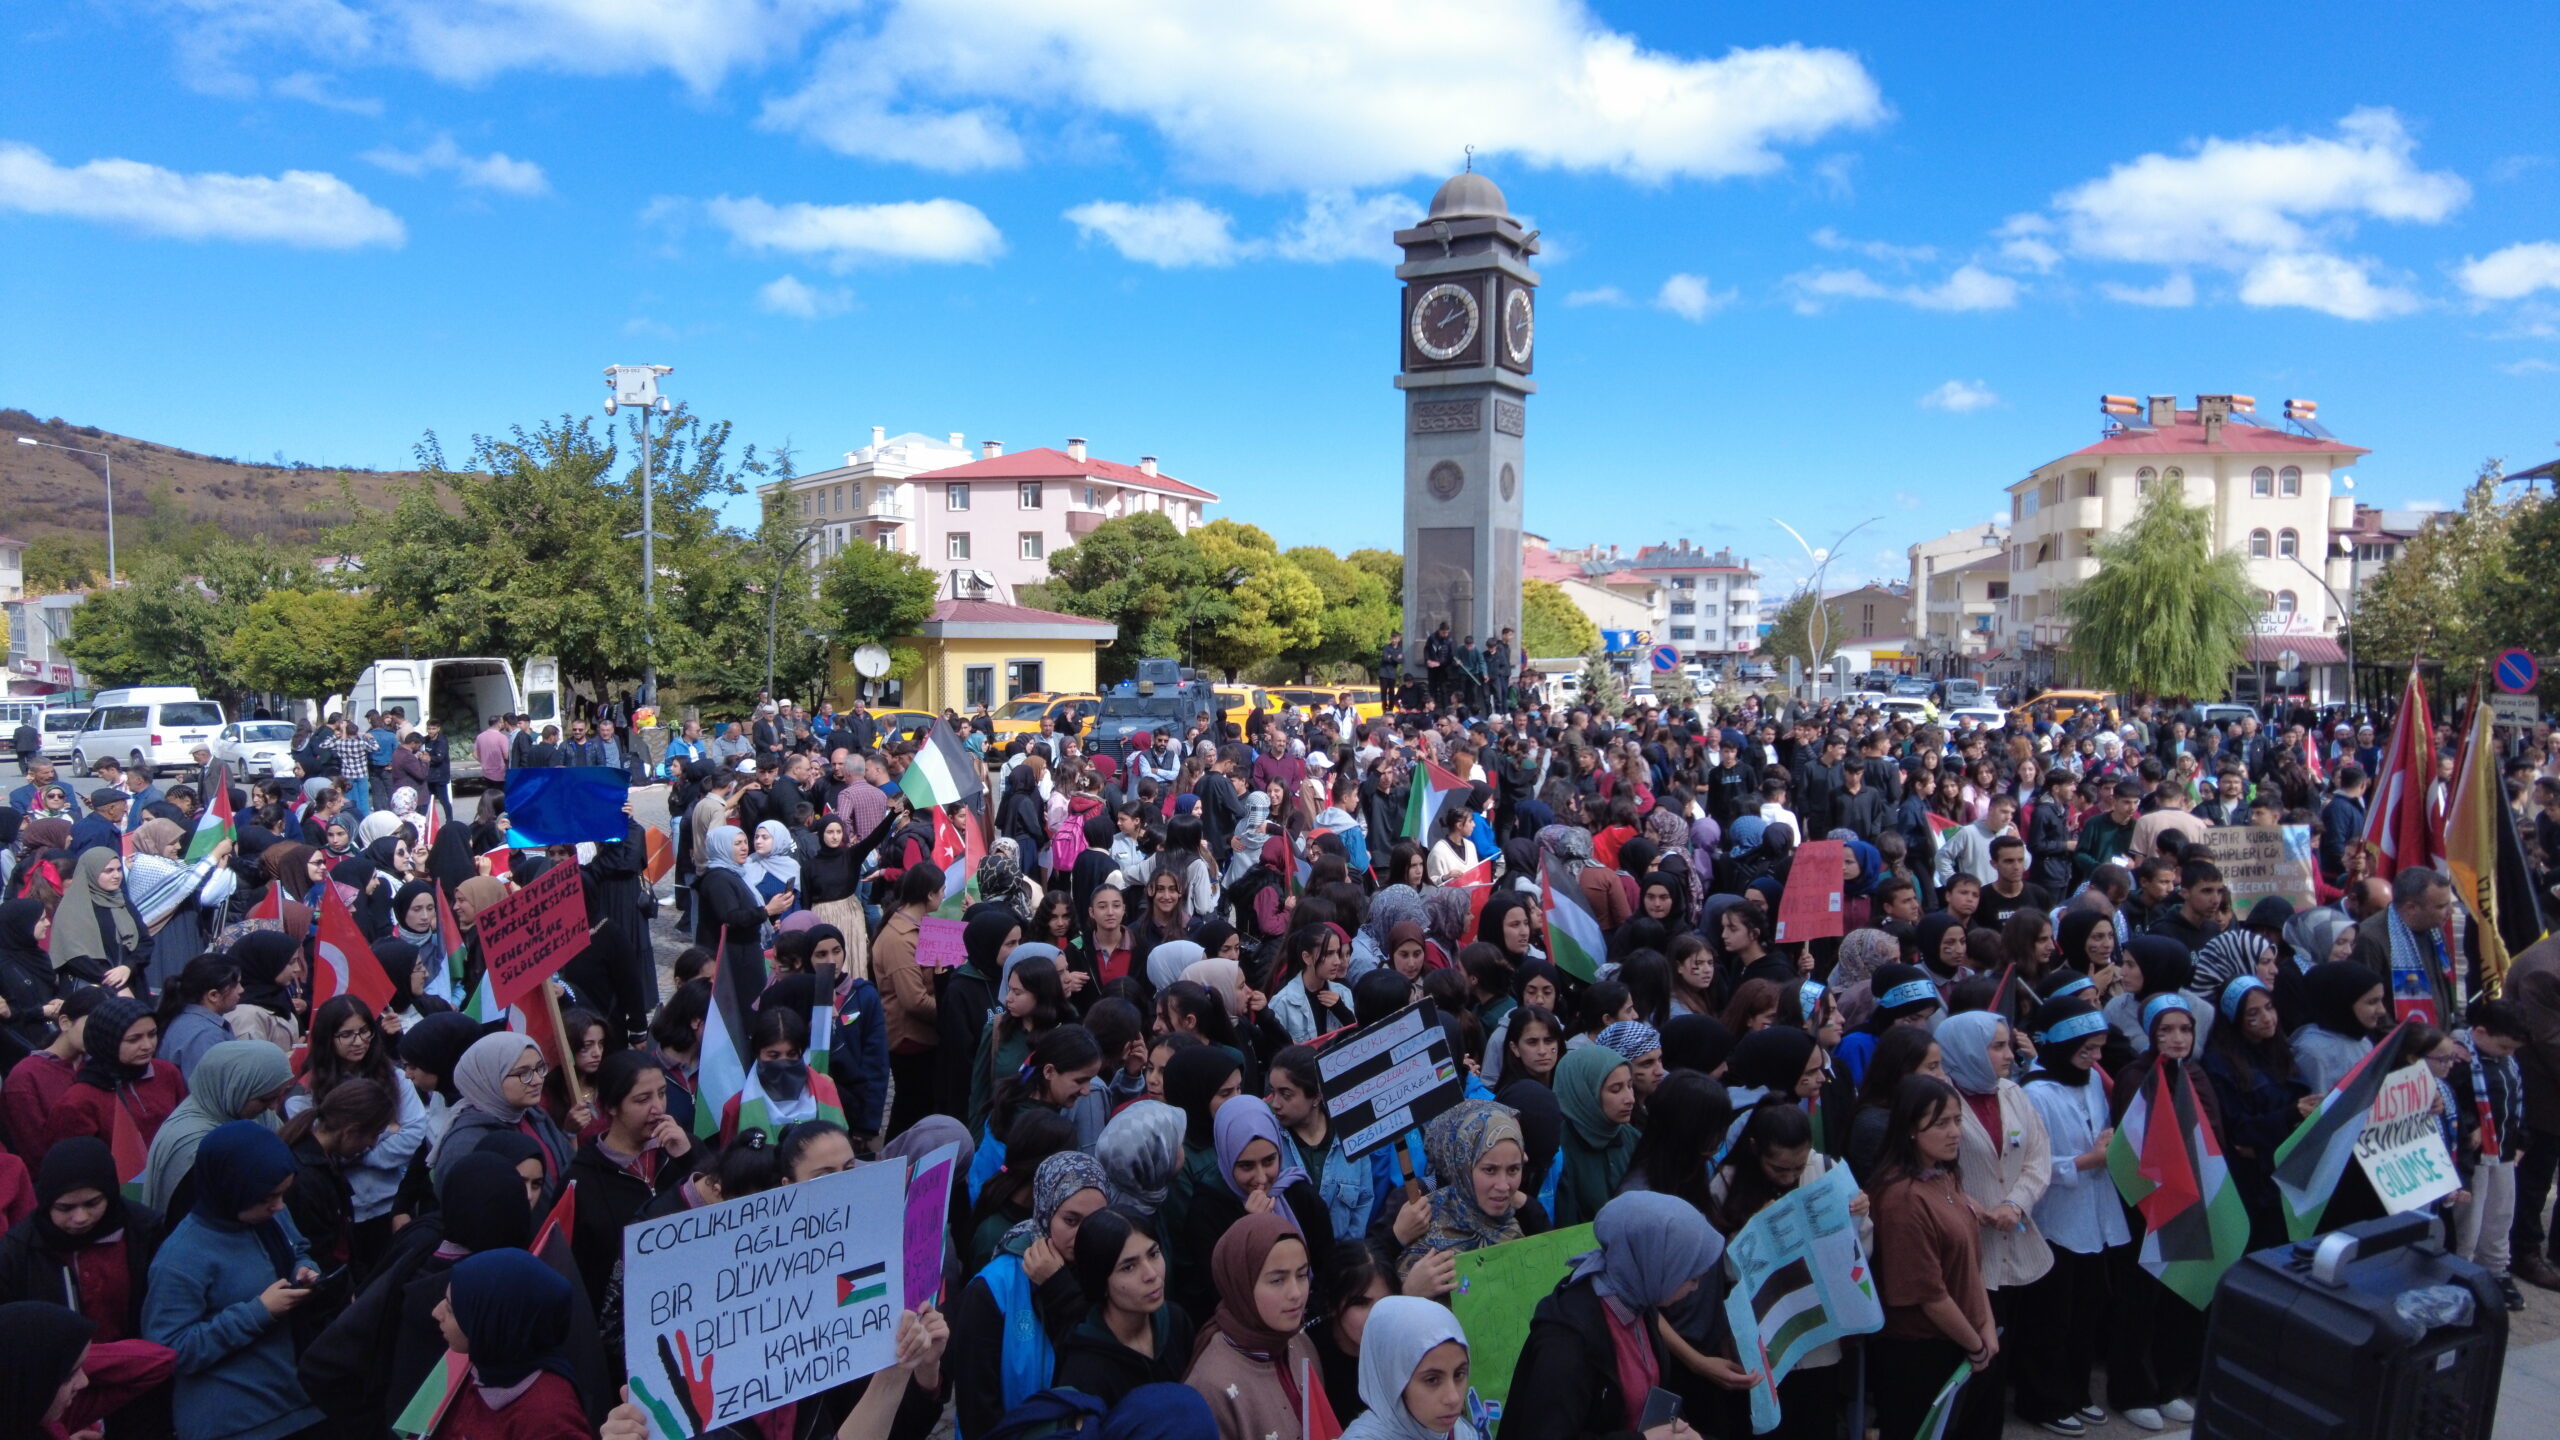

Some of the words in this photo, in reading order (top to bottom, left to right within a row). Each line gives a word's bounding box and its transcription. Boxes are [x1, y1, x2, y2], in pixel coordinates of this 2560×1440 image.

[525, 918, 542, 936] VE
[735, 1205, 851, 1260] AĞLADIĞI
[650, 1282, 693, 1327] BİR
[716, 1241, 845, 1303] DÜNYADA
[695, 1290, 814, 1357] BÜTÜN
[764, 1304, 891, 1370] KAHKALAR
[716, 1346, 850, 1420] ZALİMDİR
